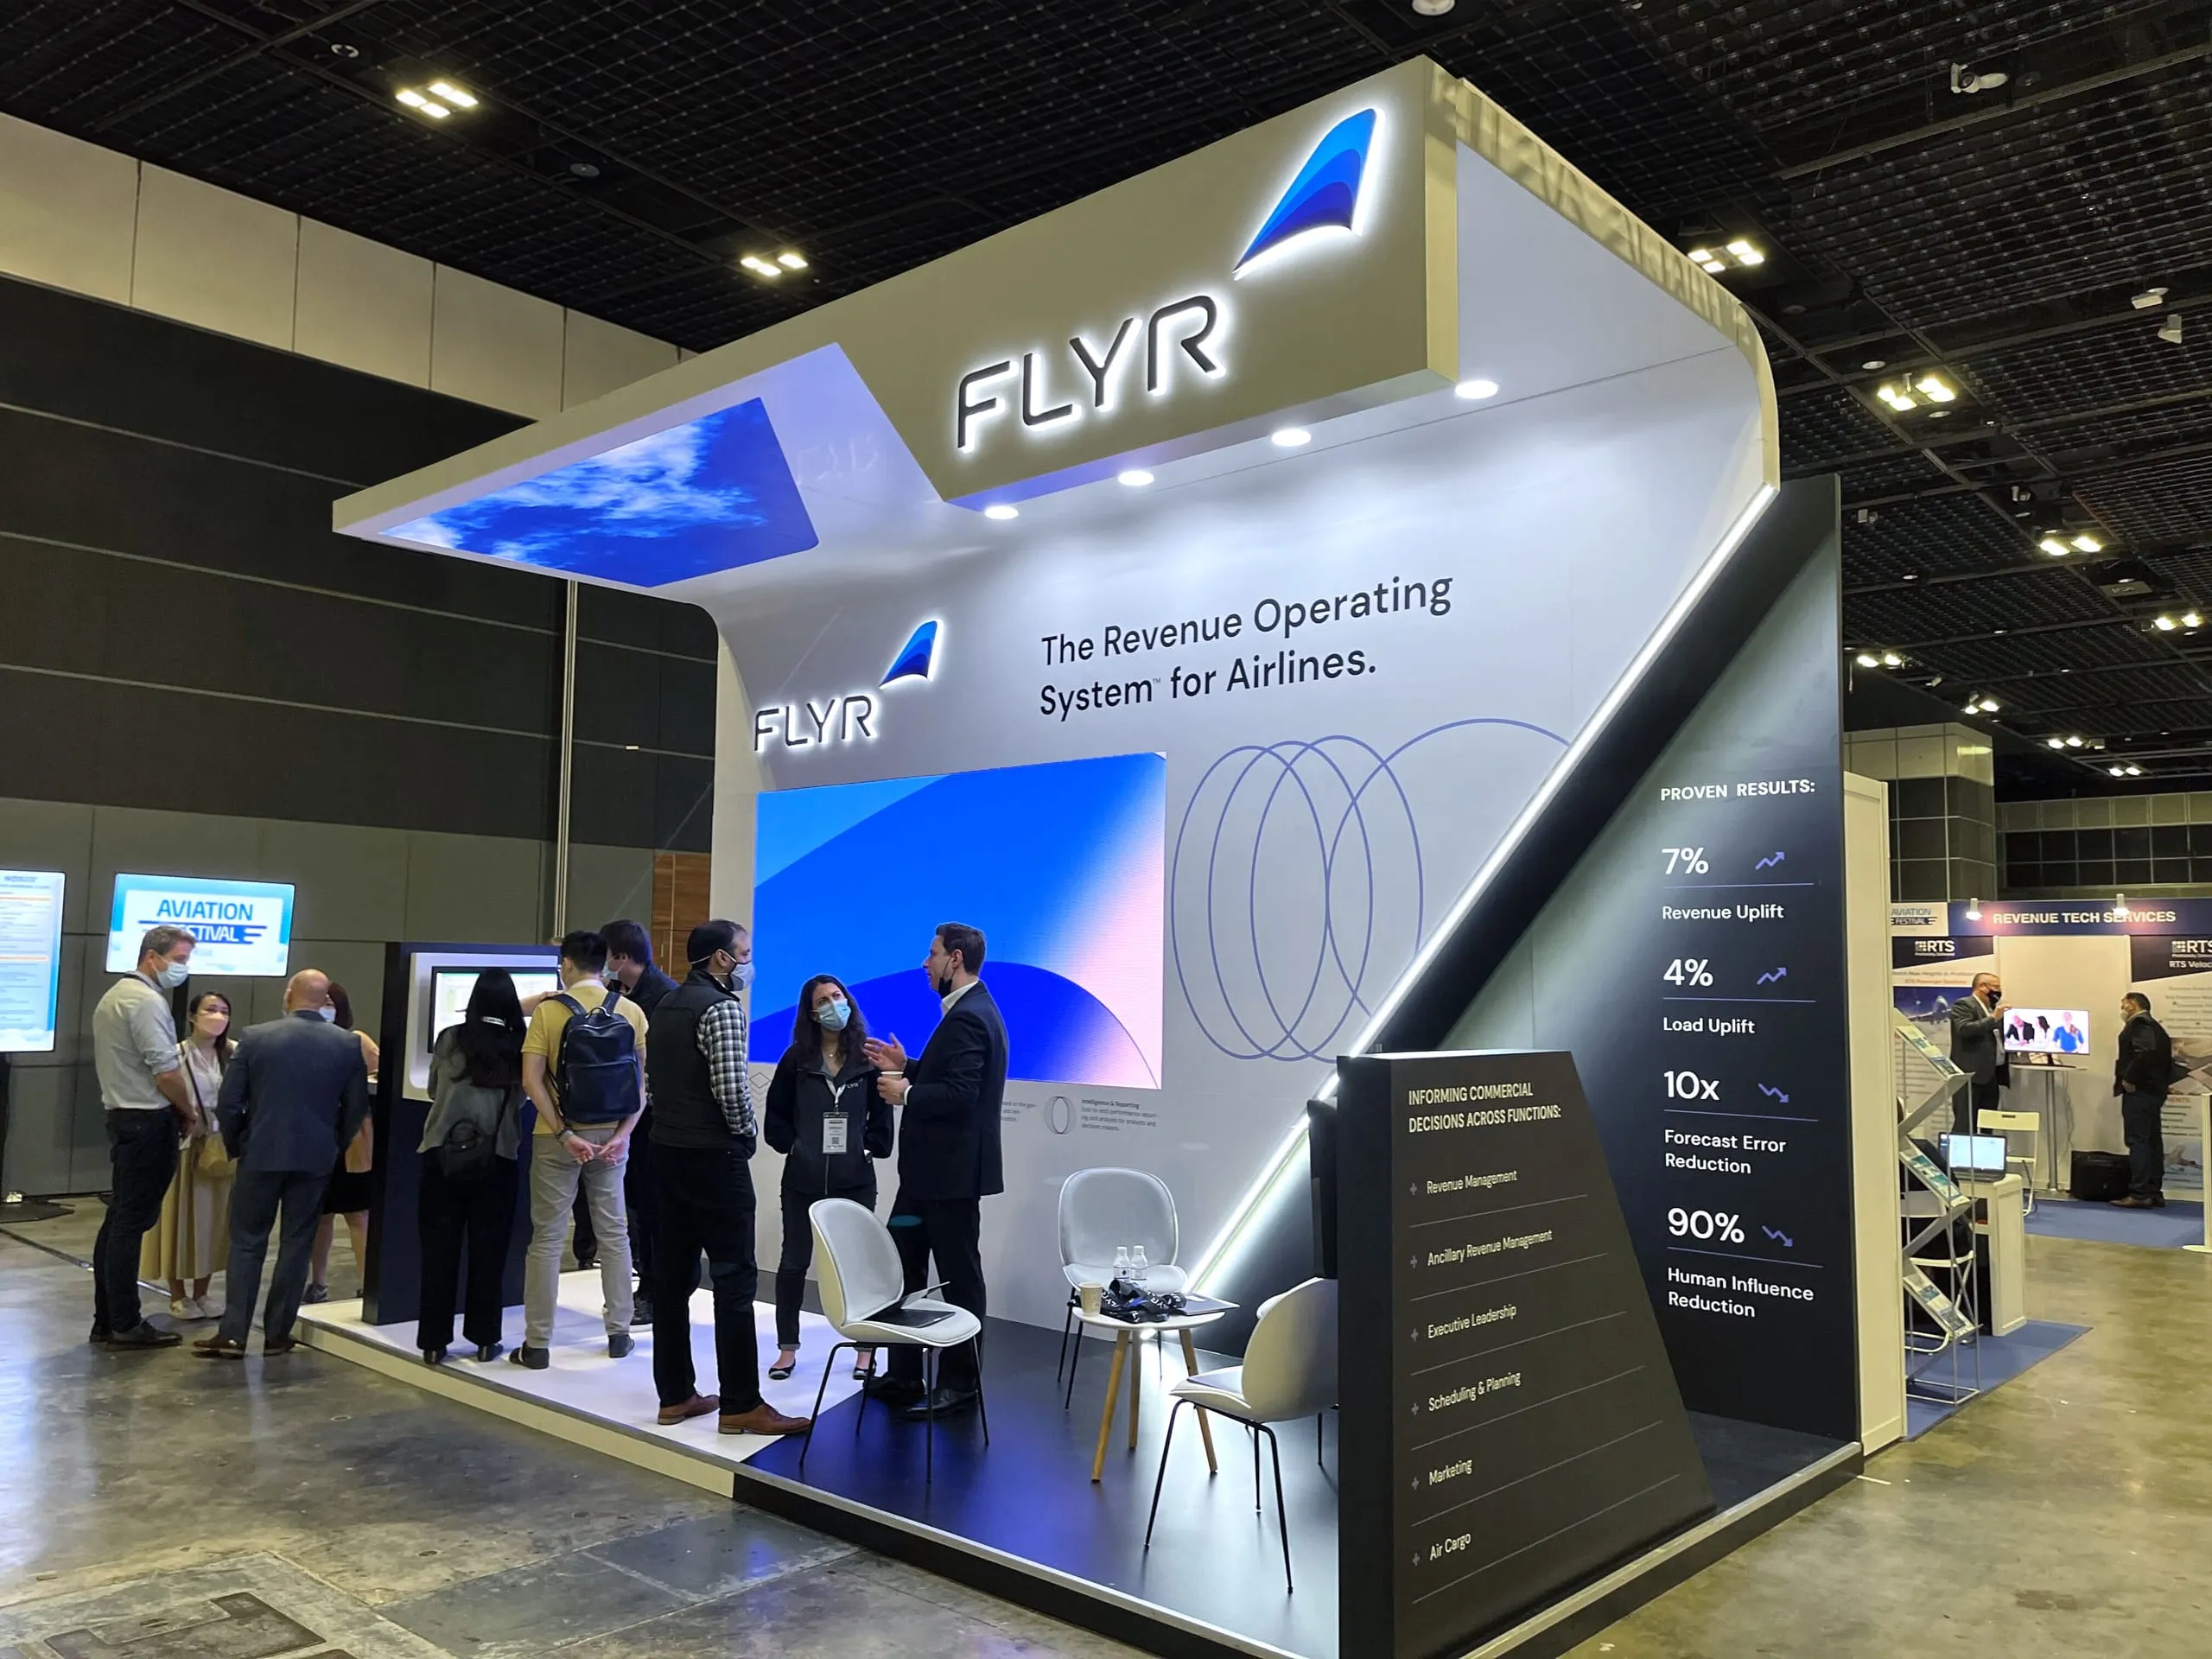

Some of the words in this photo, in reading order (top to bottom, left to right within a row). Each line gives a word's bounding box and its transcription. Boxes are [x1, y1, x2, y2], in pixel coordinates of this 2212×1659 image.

[957, 296, 1219, 449] FLYR
[1041, 633, 1095, 665] The
[1103, 613, 1243, 657] Revenue
[1254, 576, 1454, 638] Operating
[1171, 666, 1217, 698] for
[1226, 649, 1377, 692] Airlines.
[753, 696, 874, 752] FLYR
[1661, 785, 1728, 801] PROVEN
[1736, 779, 1815, 797] RESULTS:
[1661, 847, 1709, 874] 7%
[156, 899, 254, 921] AVIATION
[1662, 906, 1732, 919] Revenue
[1736, 904, 1784, 922] Uplift
[1993, 912, 2059, 925] REVENUE
[2064, 912, 2100, 924] TECH
[2103, 911, 2177, 923] SERVICES
[177, 924, 239, 942] STIVAL
[1928, 940, 1955, 952] RTS
[1662, 959, 1713, 987] 4%
[1662, 1017, 1703, 1032] Load
[1708, 1018, 1755, 1036] Uplift
[1408, 1087, 1468, 1105] INFORMING
[1469, 1083, 1534, 1101] COMMERCIAL
[1663, 1071, 1719, 1100] 10x
[1408, 1112, 1465, 1133] DECISIONS
[1466, 1109, 1506, 1128] ACROSS
[1507, 1104, 1561, 1123] FUNCTIONS:
[1664, 1129, 1738, 1148] Forecast
[1743, 1135, 1787, 1152] Error
[1665, 1153, 1751, 1173] Reduction
[1427, 1178, 1463, 1195] Revenue
[1465, 1170, 1517, 1189] Management
[1667, 1207, 1745, 1243] 90%
[1427, 1248, 1465, 1267] Ancillary
[1466, 1240, 1502, 1259] Revenue
[1503, 1230, 1553, 1250] Management
[1668, 1267, 1726, 1288] Human
[1732, 1276, 1815, 1300] Influence
[1669, 1292, 1756, 1318] Reduction
[1428, 1318, 1470, 1339] Executive
[1471, 1304, 1517, 1327] Leadership
[1428, 1386, 1477, 1412] Scheduling
[1478, 1381, 1485, 1395] &
[1486, 1371, 1521, 1392] Planning
[1428, 1459, 1472, 1485] Marketing
[1430, 1545, 1443, 1560] Air
[1445, 1533, 1471, 1553] Cargo
